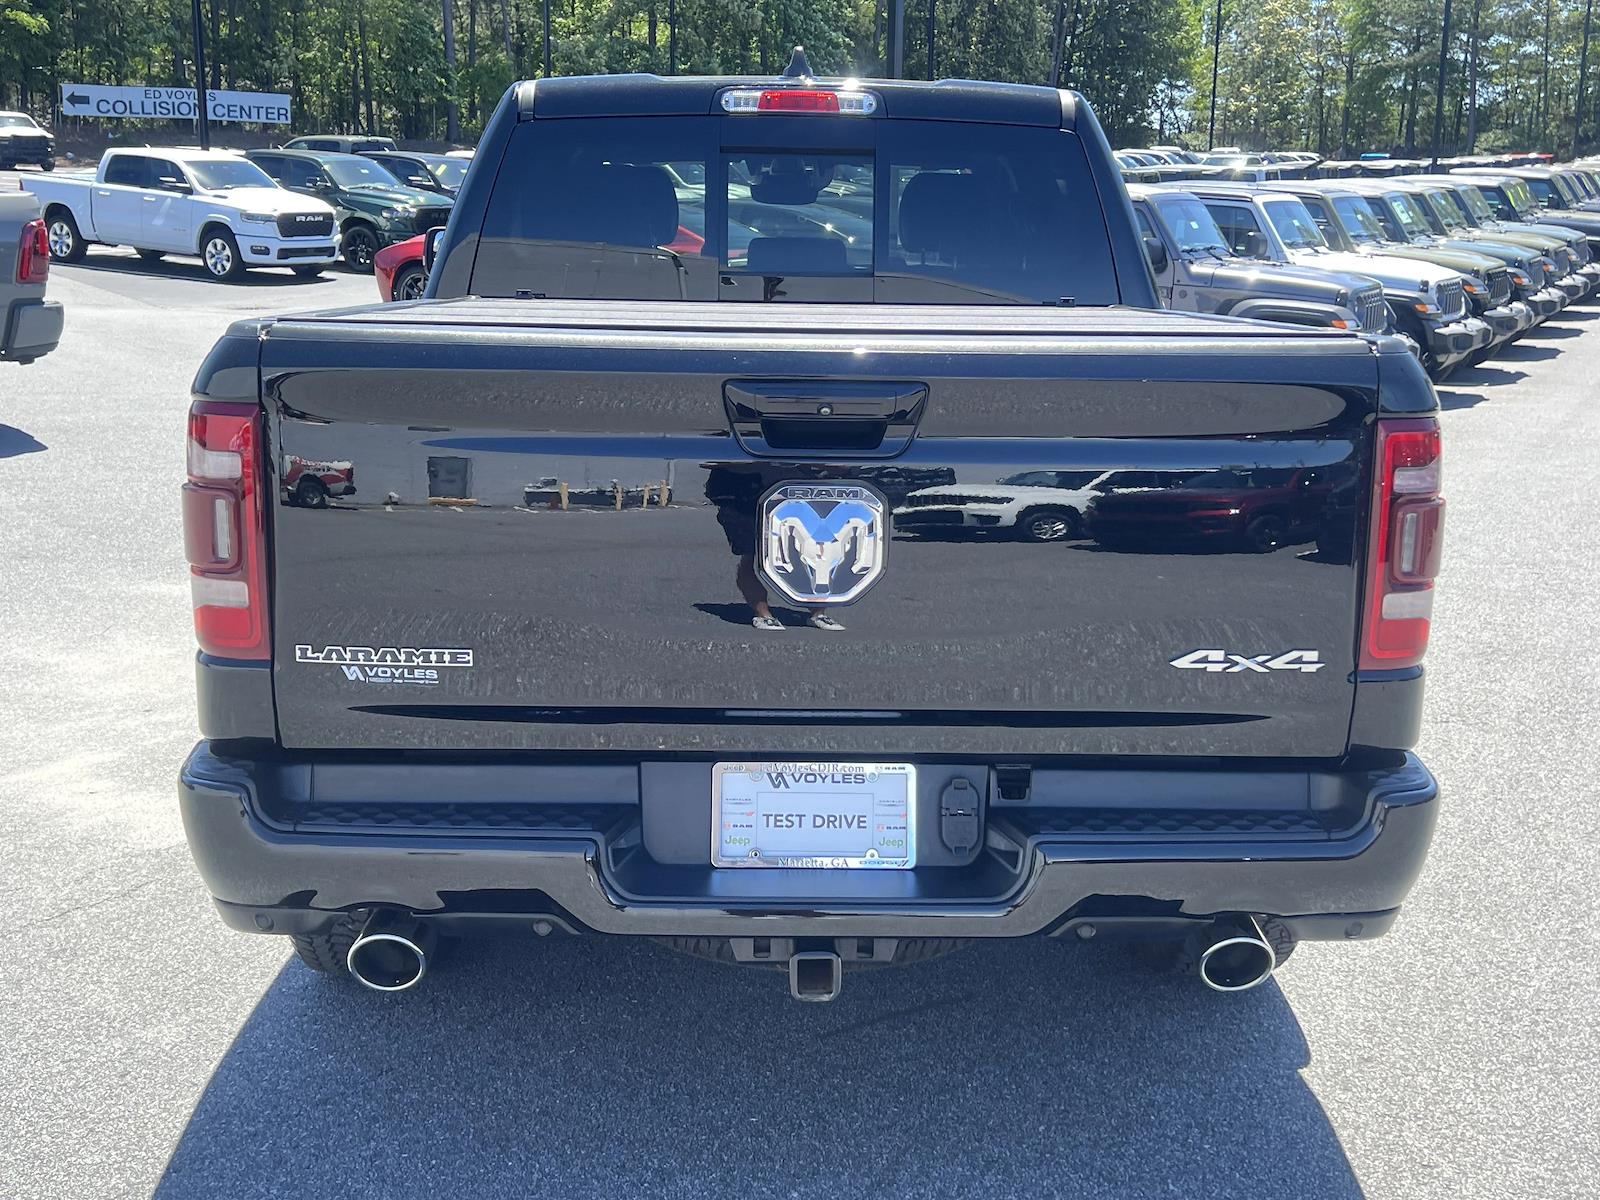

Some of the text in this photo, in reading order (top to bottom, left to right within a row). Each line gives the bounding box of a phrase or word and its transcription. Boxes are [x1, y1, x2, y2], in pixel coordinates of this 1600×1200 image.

[144, 89, 217, 102] ED VOYLS
[213, 103, 289, 121] CENTER
[787, 488, 861, 499] RAM
[295, 644, 474, 667] LARAMIE
[1169, 649, 1326, 673] 4x4
[364, 666, 438, 679] VOYLES
[791, 772, 866, 784] VOYLES
[762, 813, 867, 830] TEST DRIVE
[724, 835, 751, 846] Jeep
[878, 837, 904, 848] Jeep
[831, 857, 849, 868] GA
